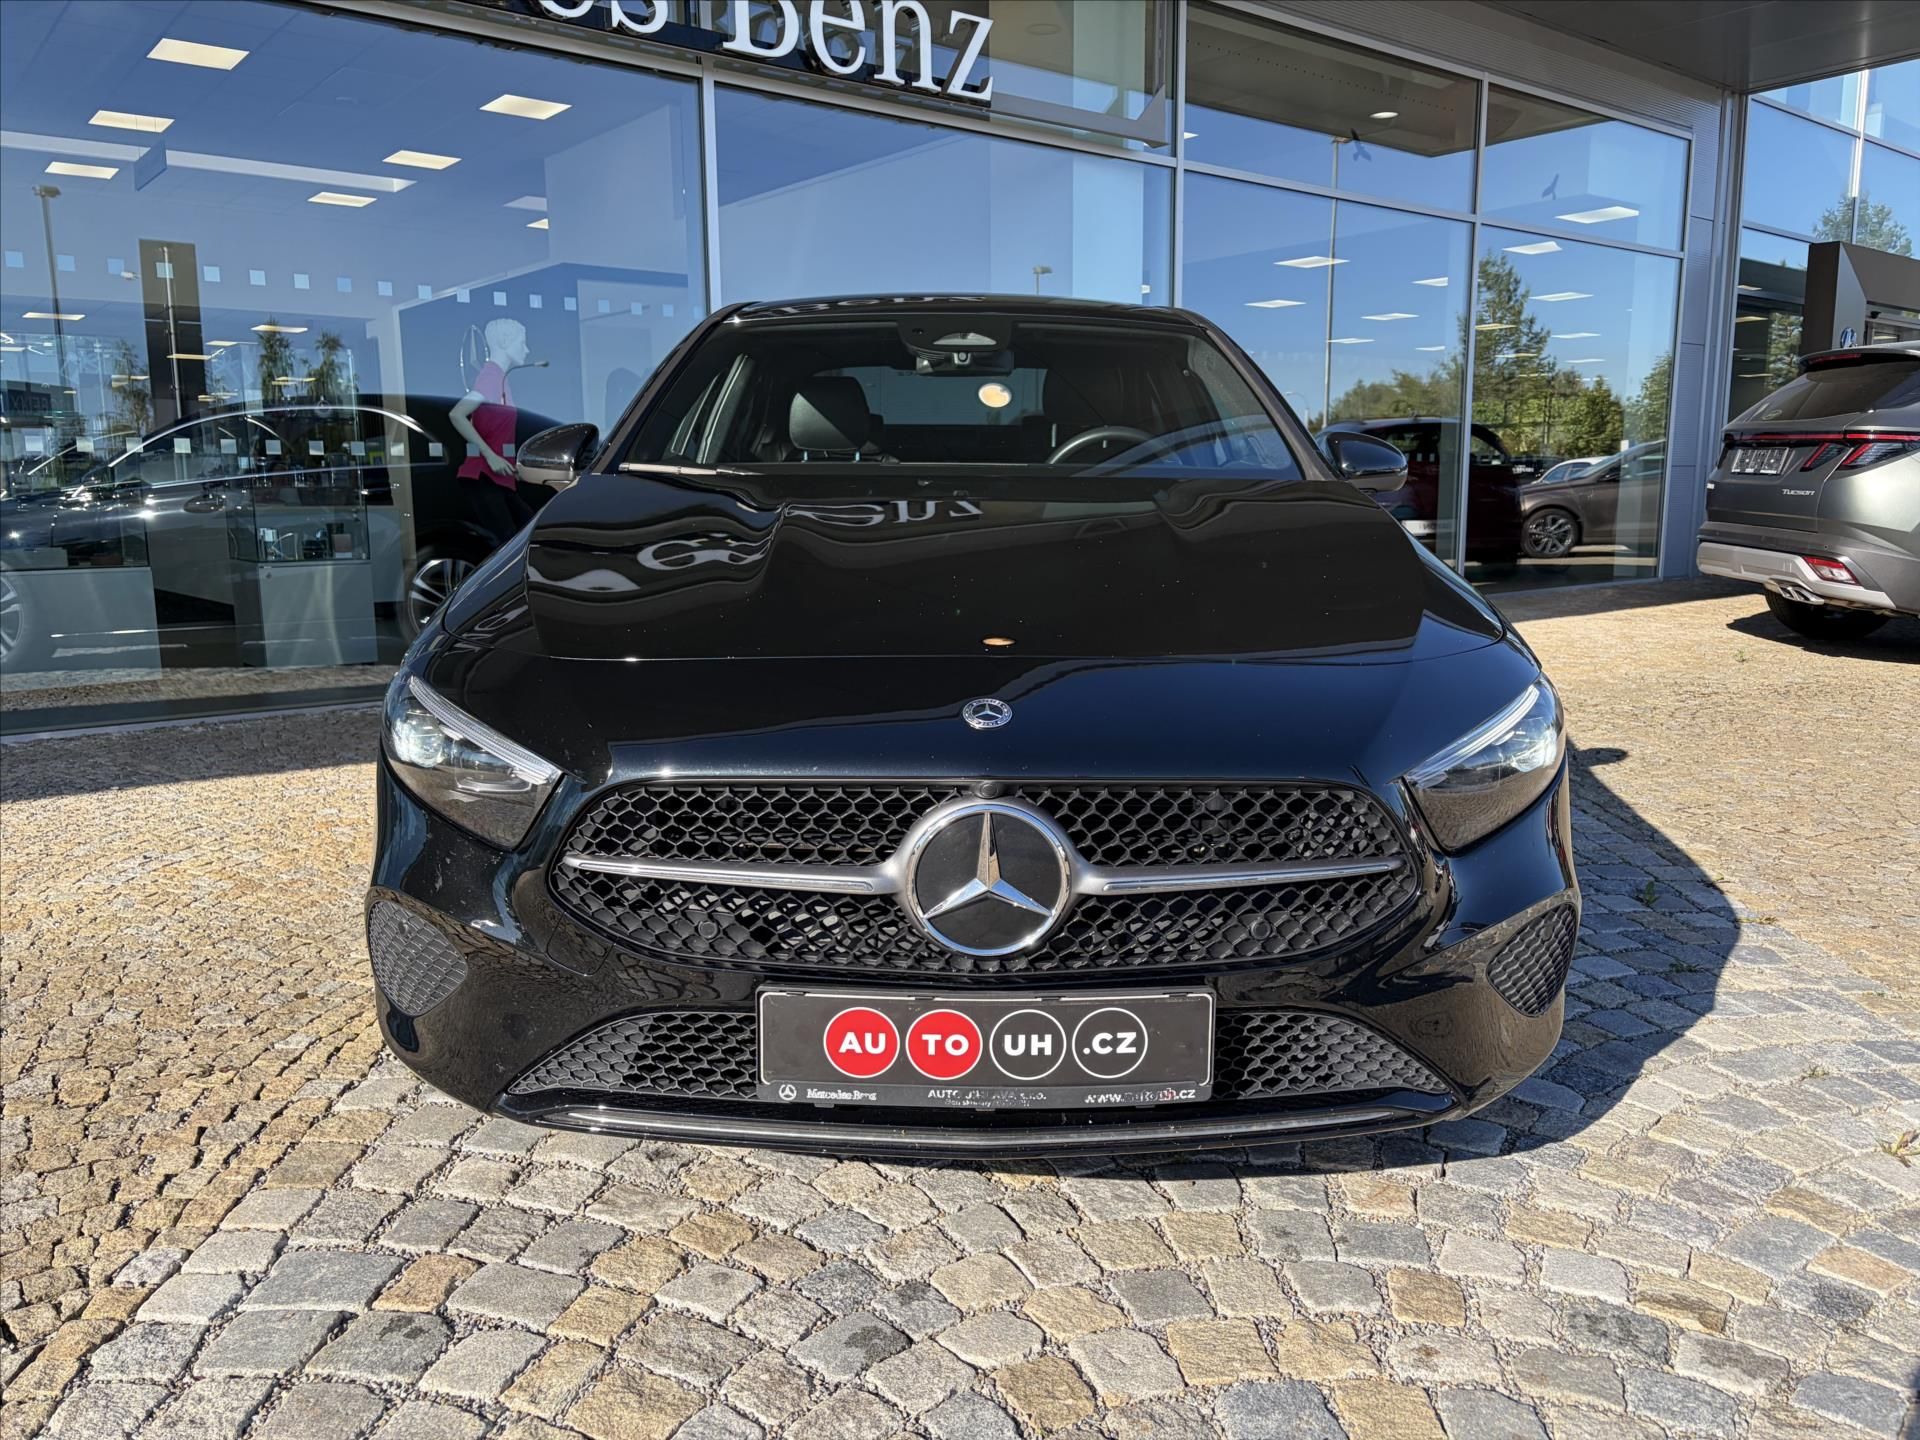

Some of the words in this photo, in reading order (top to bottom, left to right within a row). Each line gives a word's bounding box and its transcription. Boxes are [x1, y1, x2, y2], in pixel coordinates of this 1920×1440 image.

[838, 1031, 887, 1055] AU
[921, 1033, 970, 1057] TO
[1003, 1033, 1053, 1057] UH
[1082, 1031, 1137, 1056] .CZ
